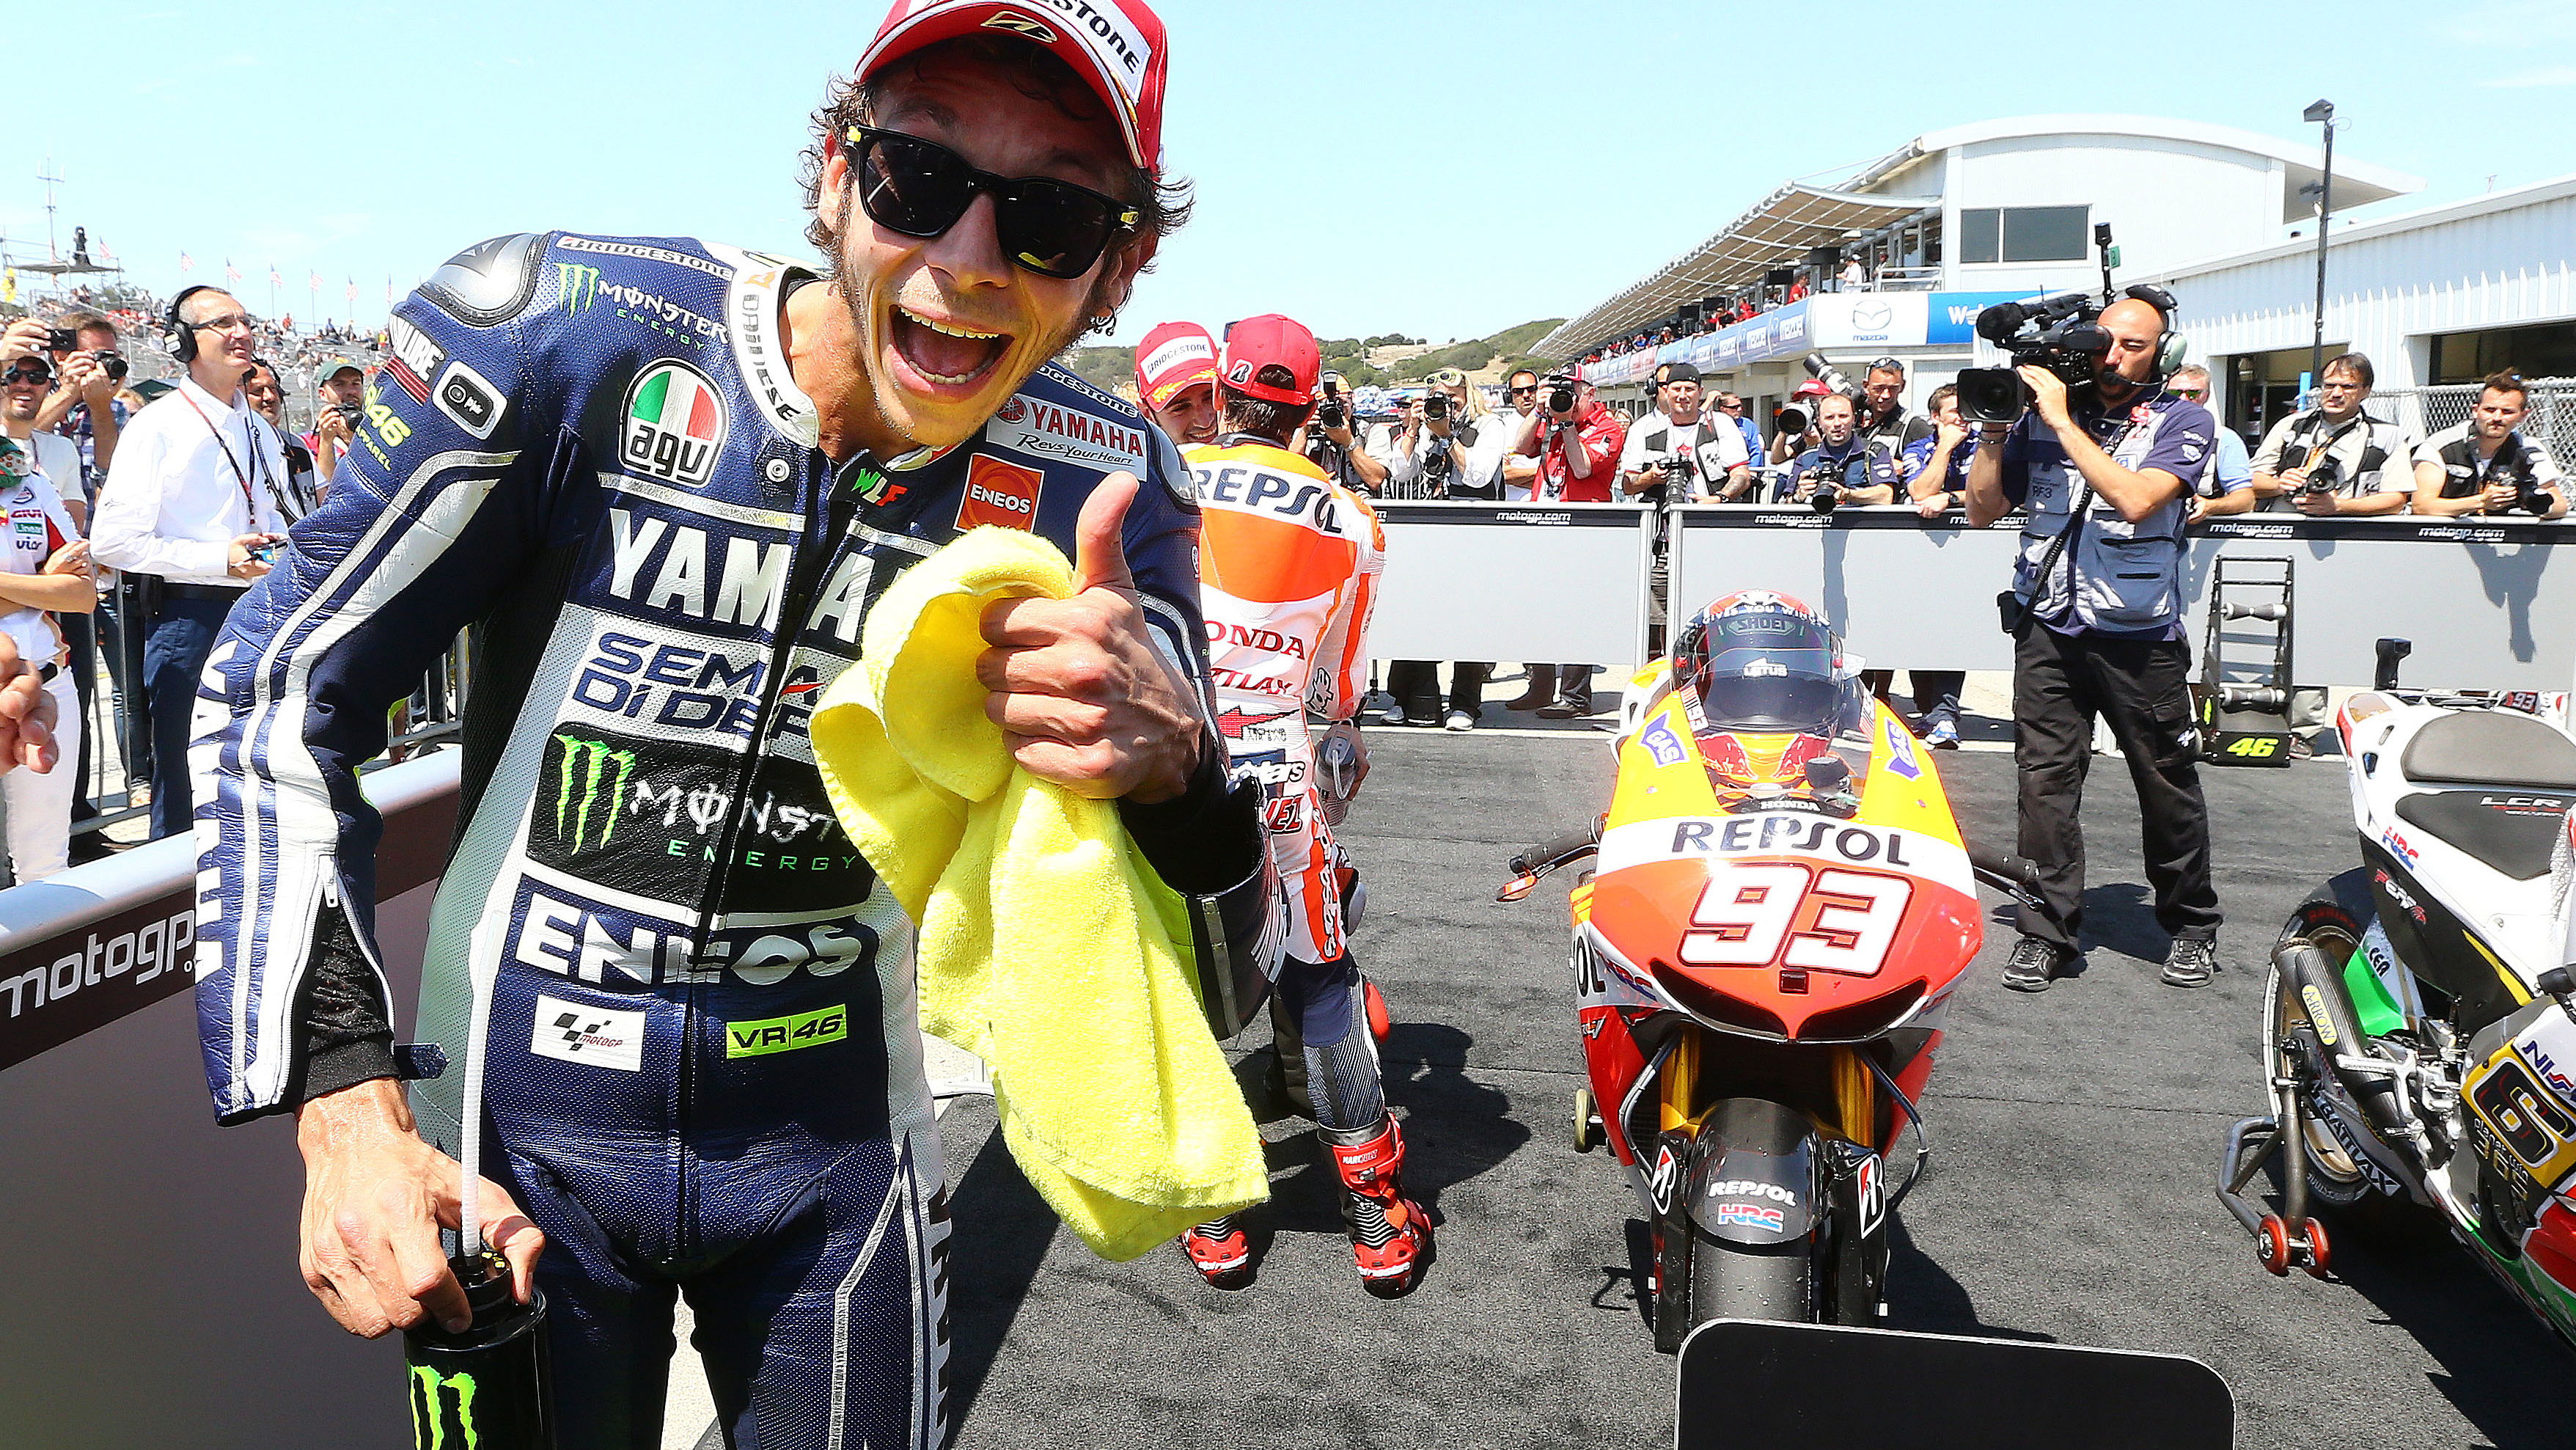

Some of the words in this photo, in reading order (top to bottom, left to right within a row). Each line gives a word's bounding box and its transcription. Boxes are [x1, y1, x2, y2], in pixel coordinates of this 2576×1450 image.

[1041, 0, 1140, 73] STONE
[563, 238, 733, 277] BRIDGESTONE
[598, 280, 730, 344] MONSTER
[617, 308, 705, 351] ENERGY
[1148, 343, 1208, 376] BRIDGESTONE
[1030, 400, 1144, 458] YAMAHA
[629, 423, 709, 477] agv
[969, 483, 1032, 514] ENEOS
[1496, 510, 1571, 524] motogp.com
[1755, 514, 1832, 527] motogp.com
[2209, 523, 2294, 538] motogp.com
[2418, 526, 2506, 542] motogp.com
[609, 508, 907, 645] YAMA
[1203, 620, 1306, 660] ONDA
[1742, 665, 1788, 678] LOTUS
[2513, 692, 2536, 711] 93
[2226, 737, 2280, 757] 46
[629, 779, 847, 843] MONST
[1760, 799, 1819, 812] HONDA
[2480, 796, 2562, 808] LCR
[1671, 816, 1910, 867] REPSOL
[2382, 827, 2418, 871] HRC
[515, 893, 862, 986] ENEOS
[1677, 861, 1915, 979] 93
[2304, 990, 2335, 1040] ARROW
[2522, 1039, 2576, 1102] NIS
[2319, 1102, 2396, 1193] BATTLAX
[1709, 1181, 1798, 1207] REPSOL
[1717, 1204, 1784, 1234] HRC
